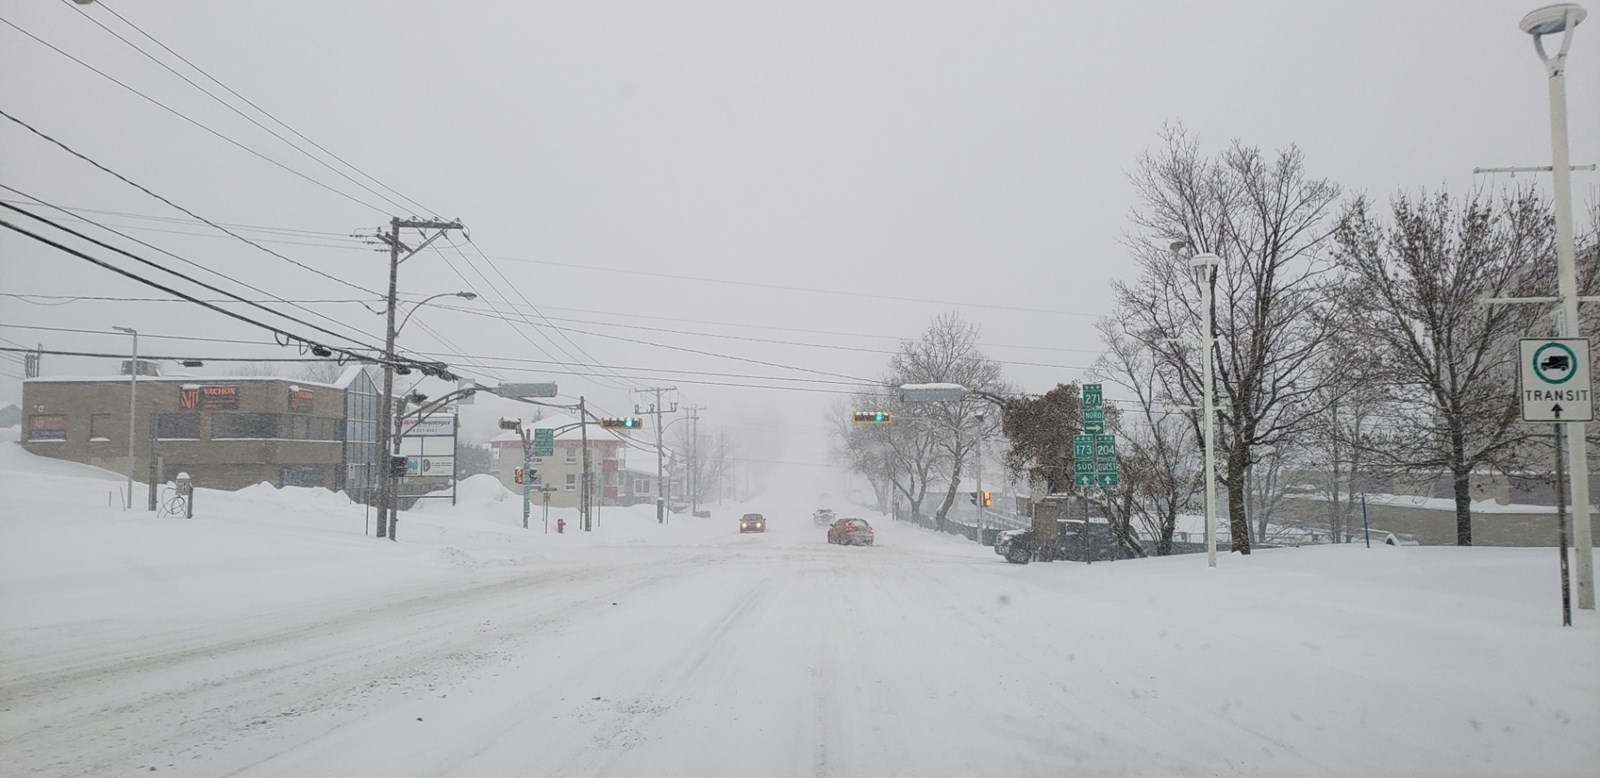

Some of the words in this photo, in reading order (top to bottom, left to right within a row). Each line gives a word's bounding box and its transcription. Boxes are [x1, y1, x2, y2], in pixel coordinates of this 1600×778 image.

[203, 387, 236, 395] VACHON
[1525, 390, 1588, 401] TRANSIT
[1085, 394, 1101, 404] 271
[1076, 445, 1092, 455] 173
[1097, 445, 1115, 455] 204
[1098, 463, 1116, 471] OUEST
